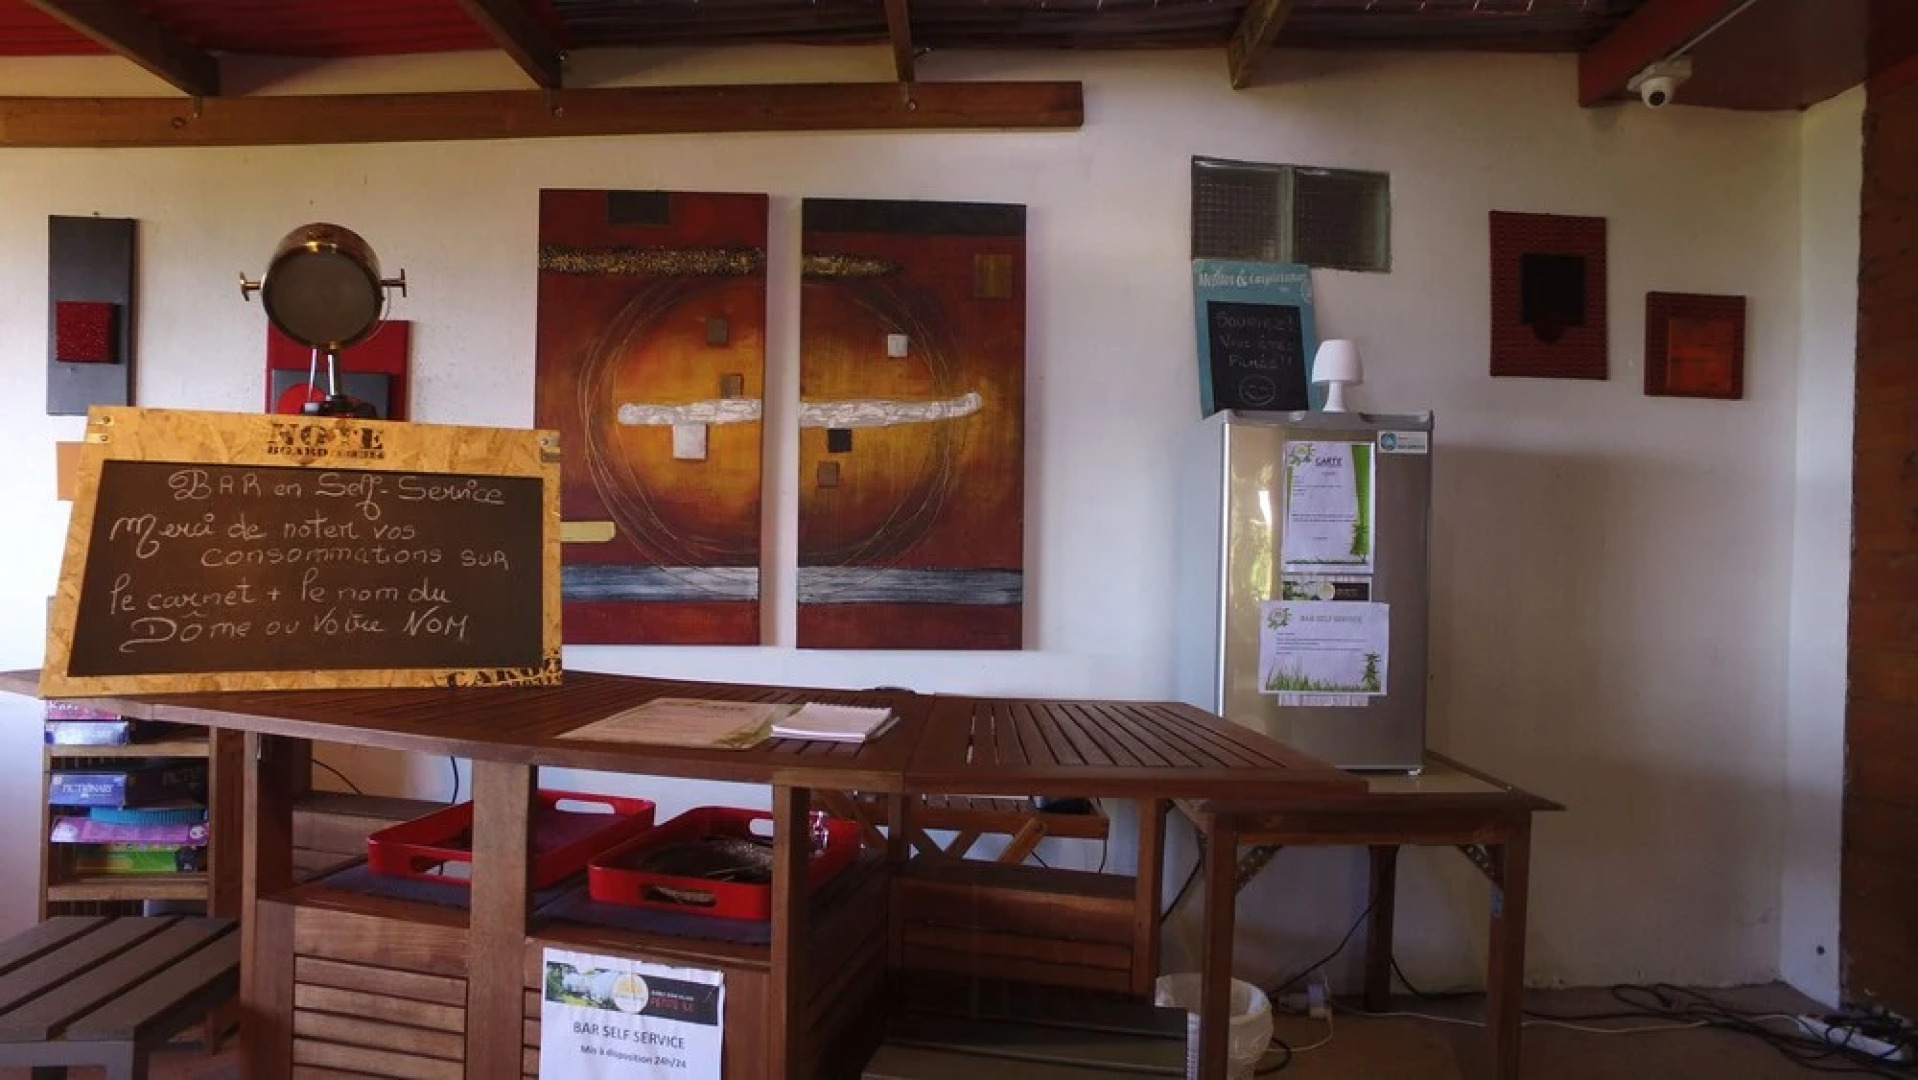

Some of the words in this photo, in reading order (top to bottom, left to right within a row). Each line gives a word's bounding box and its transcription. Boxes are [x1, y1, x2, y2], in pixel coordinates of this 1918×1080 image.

[168, 469, 262, 501] BAR
[273, 482, 302, 498] en
[109, 513, 216, 559] Merci
[227, 513, 268, 541] de
[373, 525, 416, 540] vos
[109, 573, 136, 616] le
[147, 576, 257, 611] carnet
[301, 567, 325, 602] le
[338, 586, 398, 601] nom
[407, 576, 453, 603] du
[118, 609, 252, 653] Dôme
[573, 1020, 599, 1036] BAR
[602, 1025, 631, 1041] SELF
[632, 1031, 686, 1050] SERVICE
[580, 1044, 598, 1055] Mis
[606, 1048, 653, 1064] disposition
